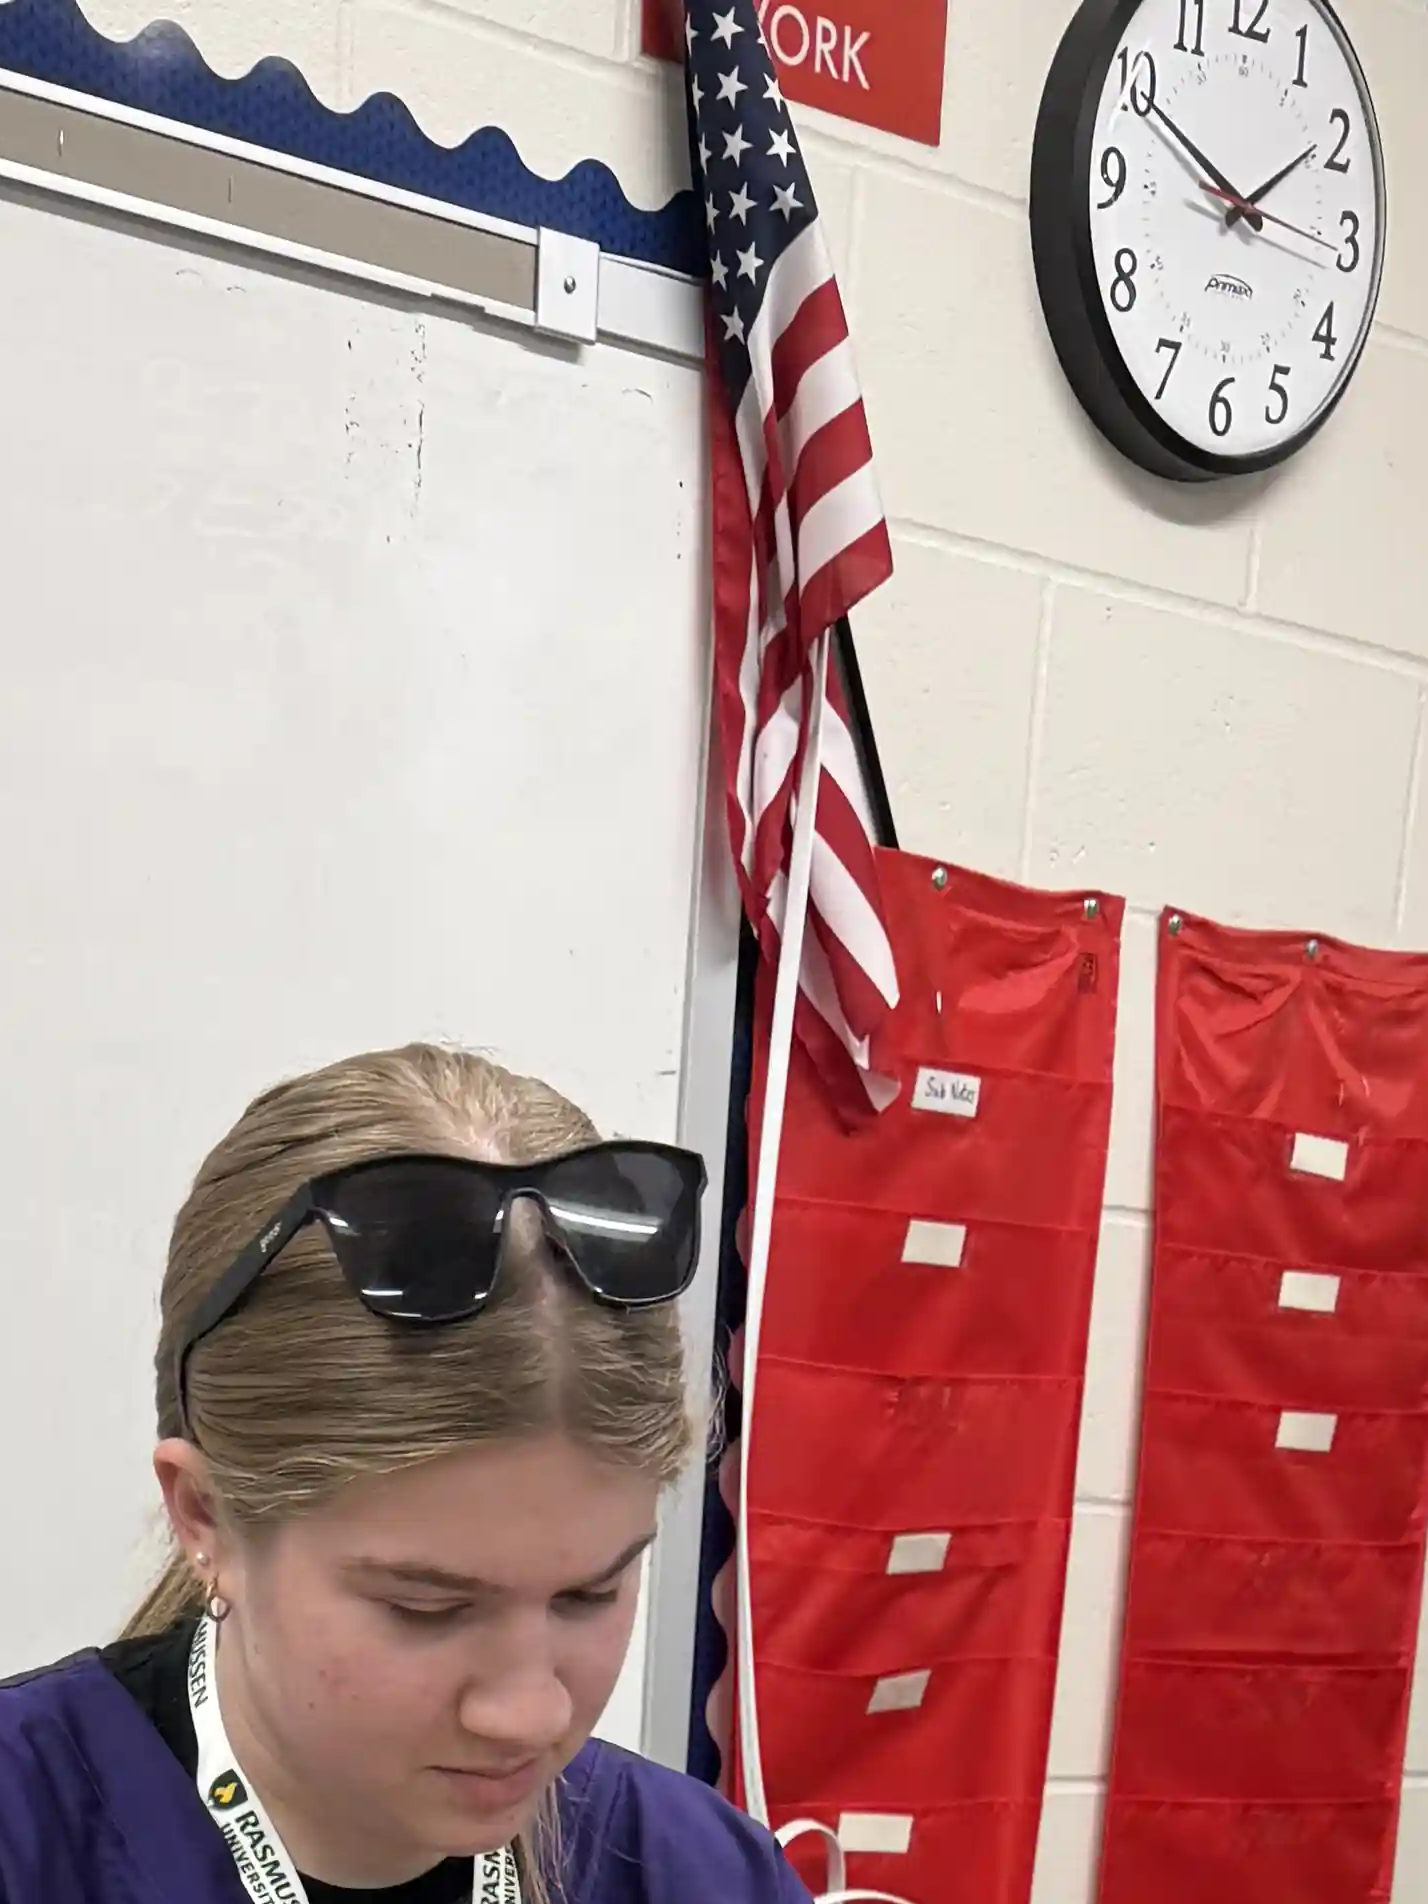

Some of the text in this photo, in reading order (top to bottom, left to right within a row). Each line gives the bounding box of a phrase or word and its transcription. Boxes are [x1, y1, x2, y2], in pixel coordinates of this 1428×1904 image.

[761, 0, 871, 91] ORK
[1174, 0, 1204, 56] 11
[1228, 0, 1270, 43] 12
[1117, 47, 1156, 117] 10
[1292, 24, 1308, 88] 1
[1324, 108, 1350, 173] 2
[1097, 146, 1126, 209] 9
[1336, 210, 1360, 272] 3
[1110, 248, 1137, 312] 8
[1312, 301, 1337, 361] 4
[1154, 338, 1182, 400] 7
[1265, 364, 1291, 424] 5
[1209, 377, 1235, 436] 6
